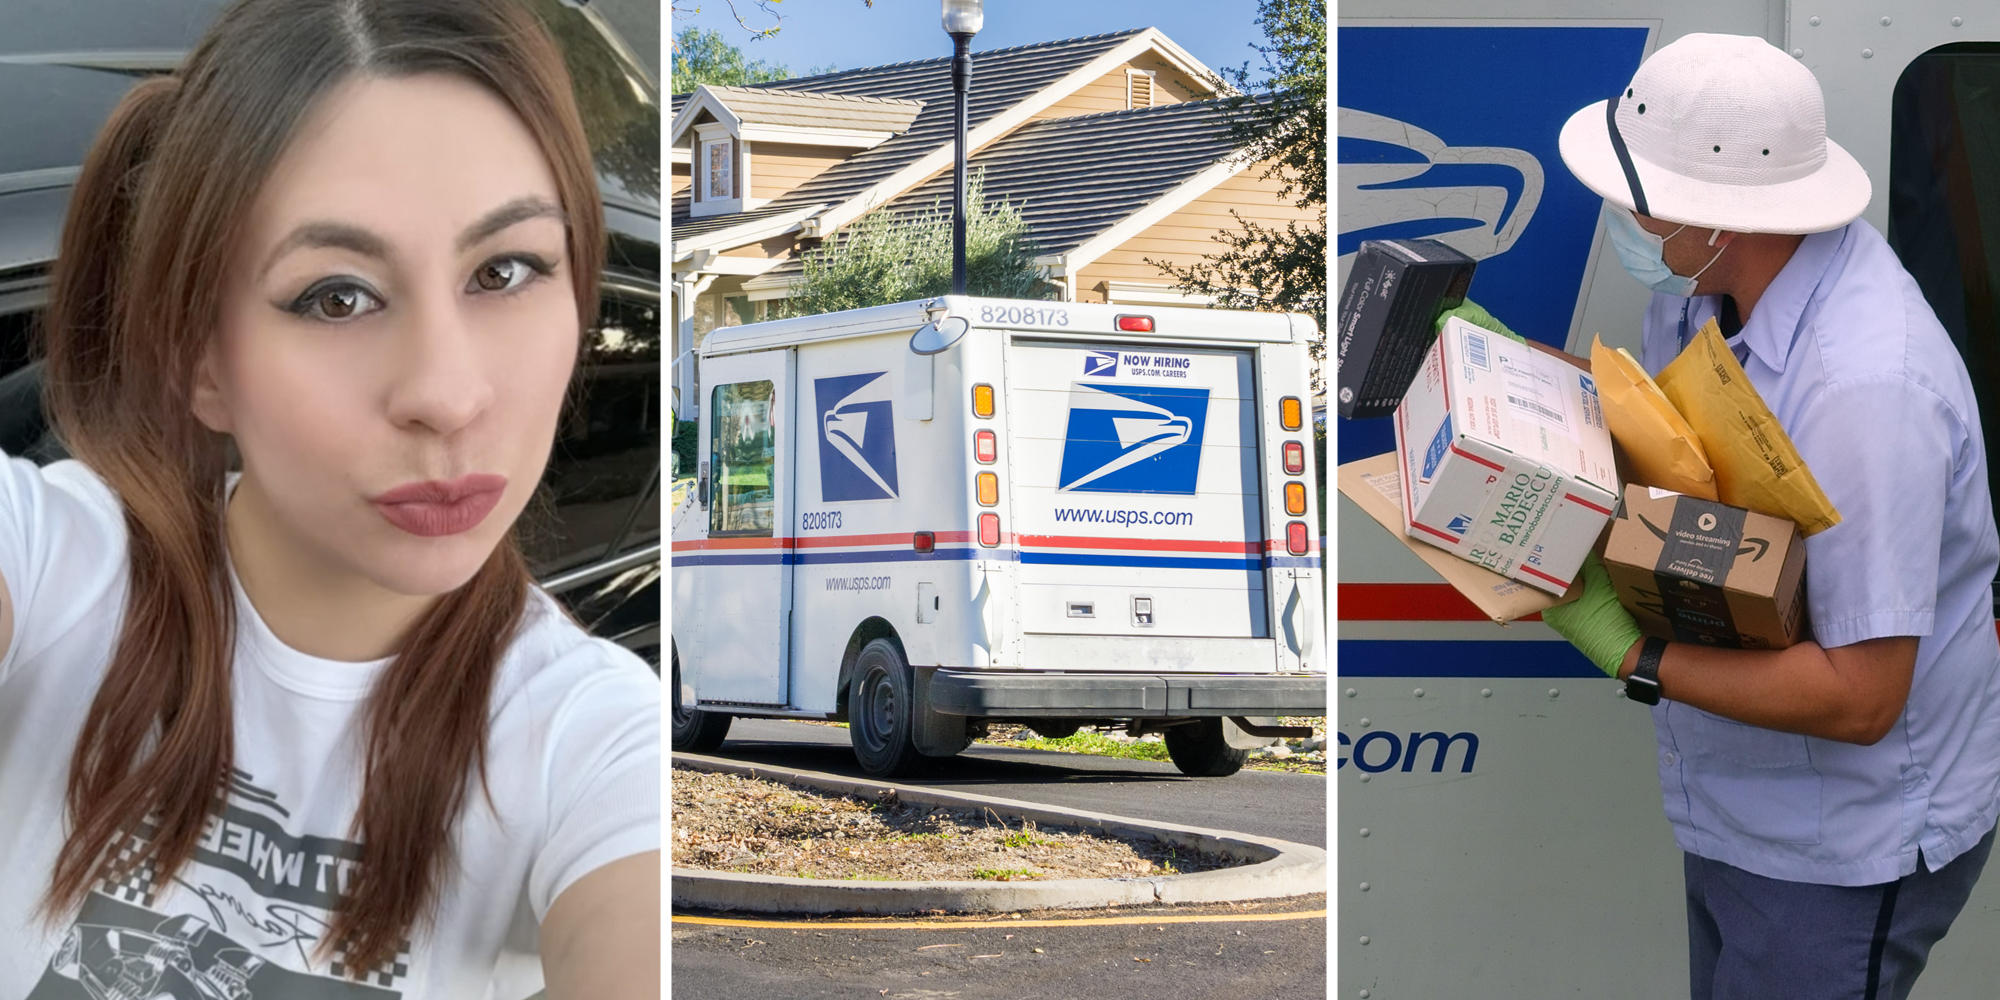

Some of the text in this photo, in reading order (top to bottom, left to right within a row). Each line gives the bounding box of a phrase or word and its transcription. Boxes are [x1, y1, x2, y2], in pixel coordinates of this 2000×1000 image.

[1364, 277, 1374, 292] Full
[1356, 291, 1369, 313] Color
[980, 305, 1070, 327] 8208173
[1347, 312, 1360, 337] Smart
[1340, 335, 1351, 357] Light
[1124, 355, 1190, 368] NOW HIRING
[1490, 473, 1530, 528] MARIO
[1499, 466, 1552, 544] BADESCU
[802, 511, 842, 531] 8208173
[1055, 506, 1193, 529] www.usps.com
[1520, 477, 1563, 547] mariobadescu.com
[1675, 530, 1731, 547] video streaming
[826, 575, 891, 592] www.usps.com
[1668, 564, 1714, 583] free delivery
[1677, 613, 1725, 626] prime
